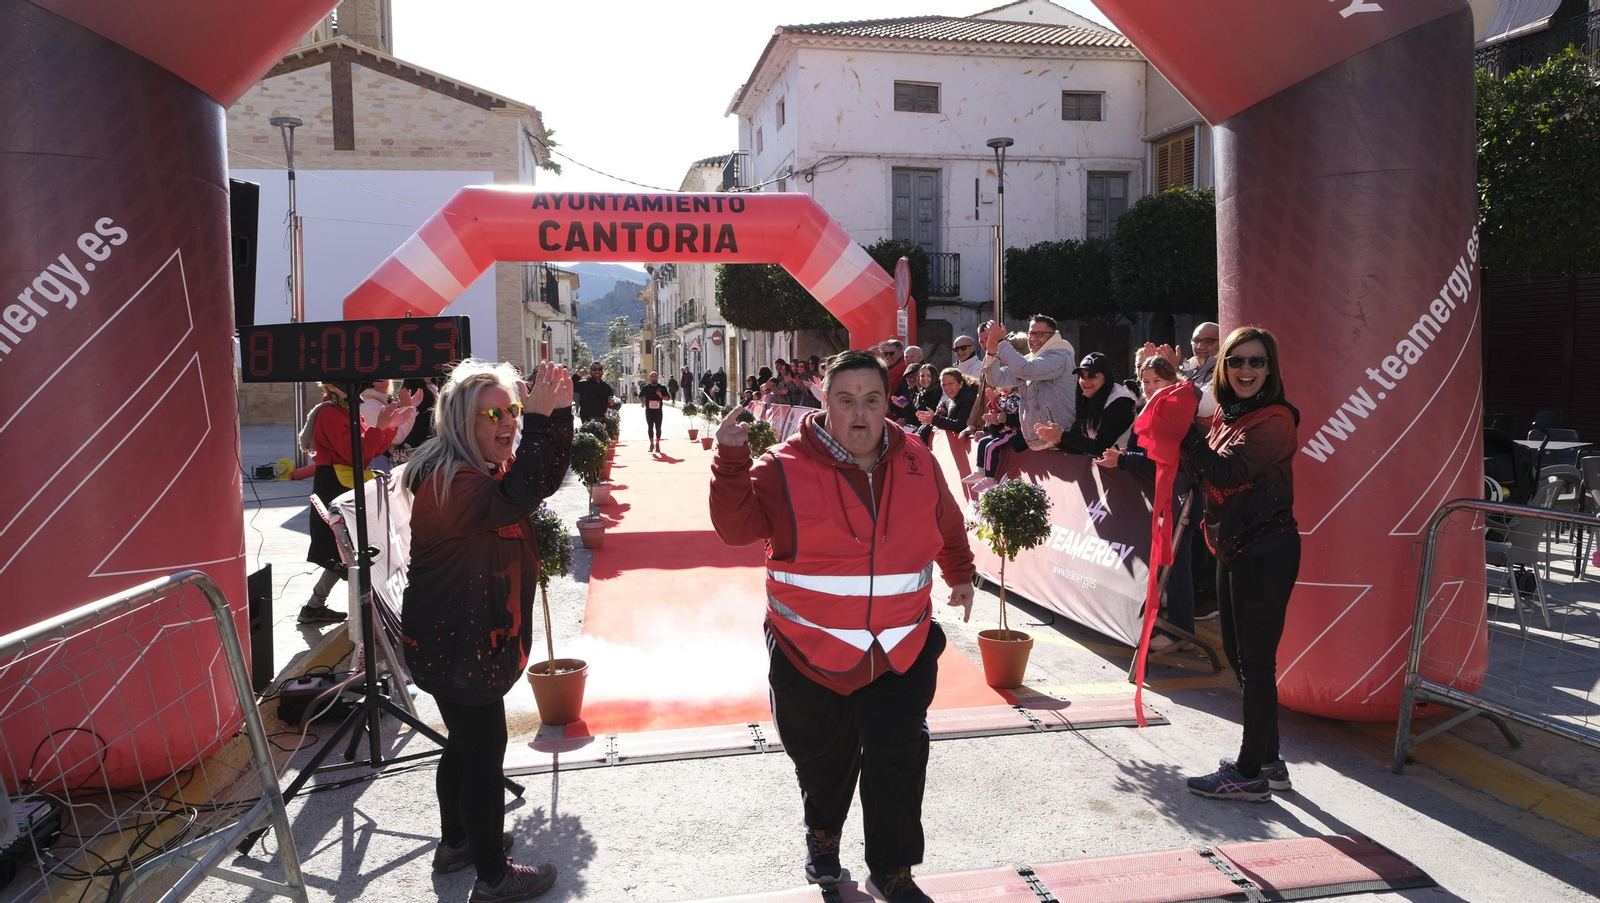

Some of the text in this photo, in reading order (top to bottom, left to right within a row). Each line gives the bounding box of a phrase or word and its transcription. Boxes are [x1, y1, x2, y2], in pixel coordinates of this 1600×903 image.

[532, 192, 746, 213] AYUNTAMIENTO
[538, 220, 738, 253] CANTORIA
[1301, 225, 1480, 463] www.teamergy.es
[1045, 525, 1135, 570] TEAMERGY
